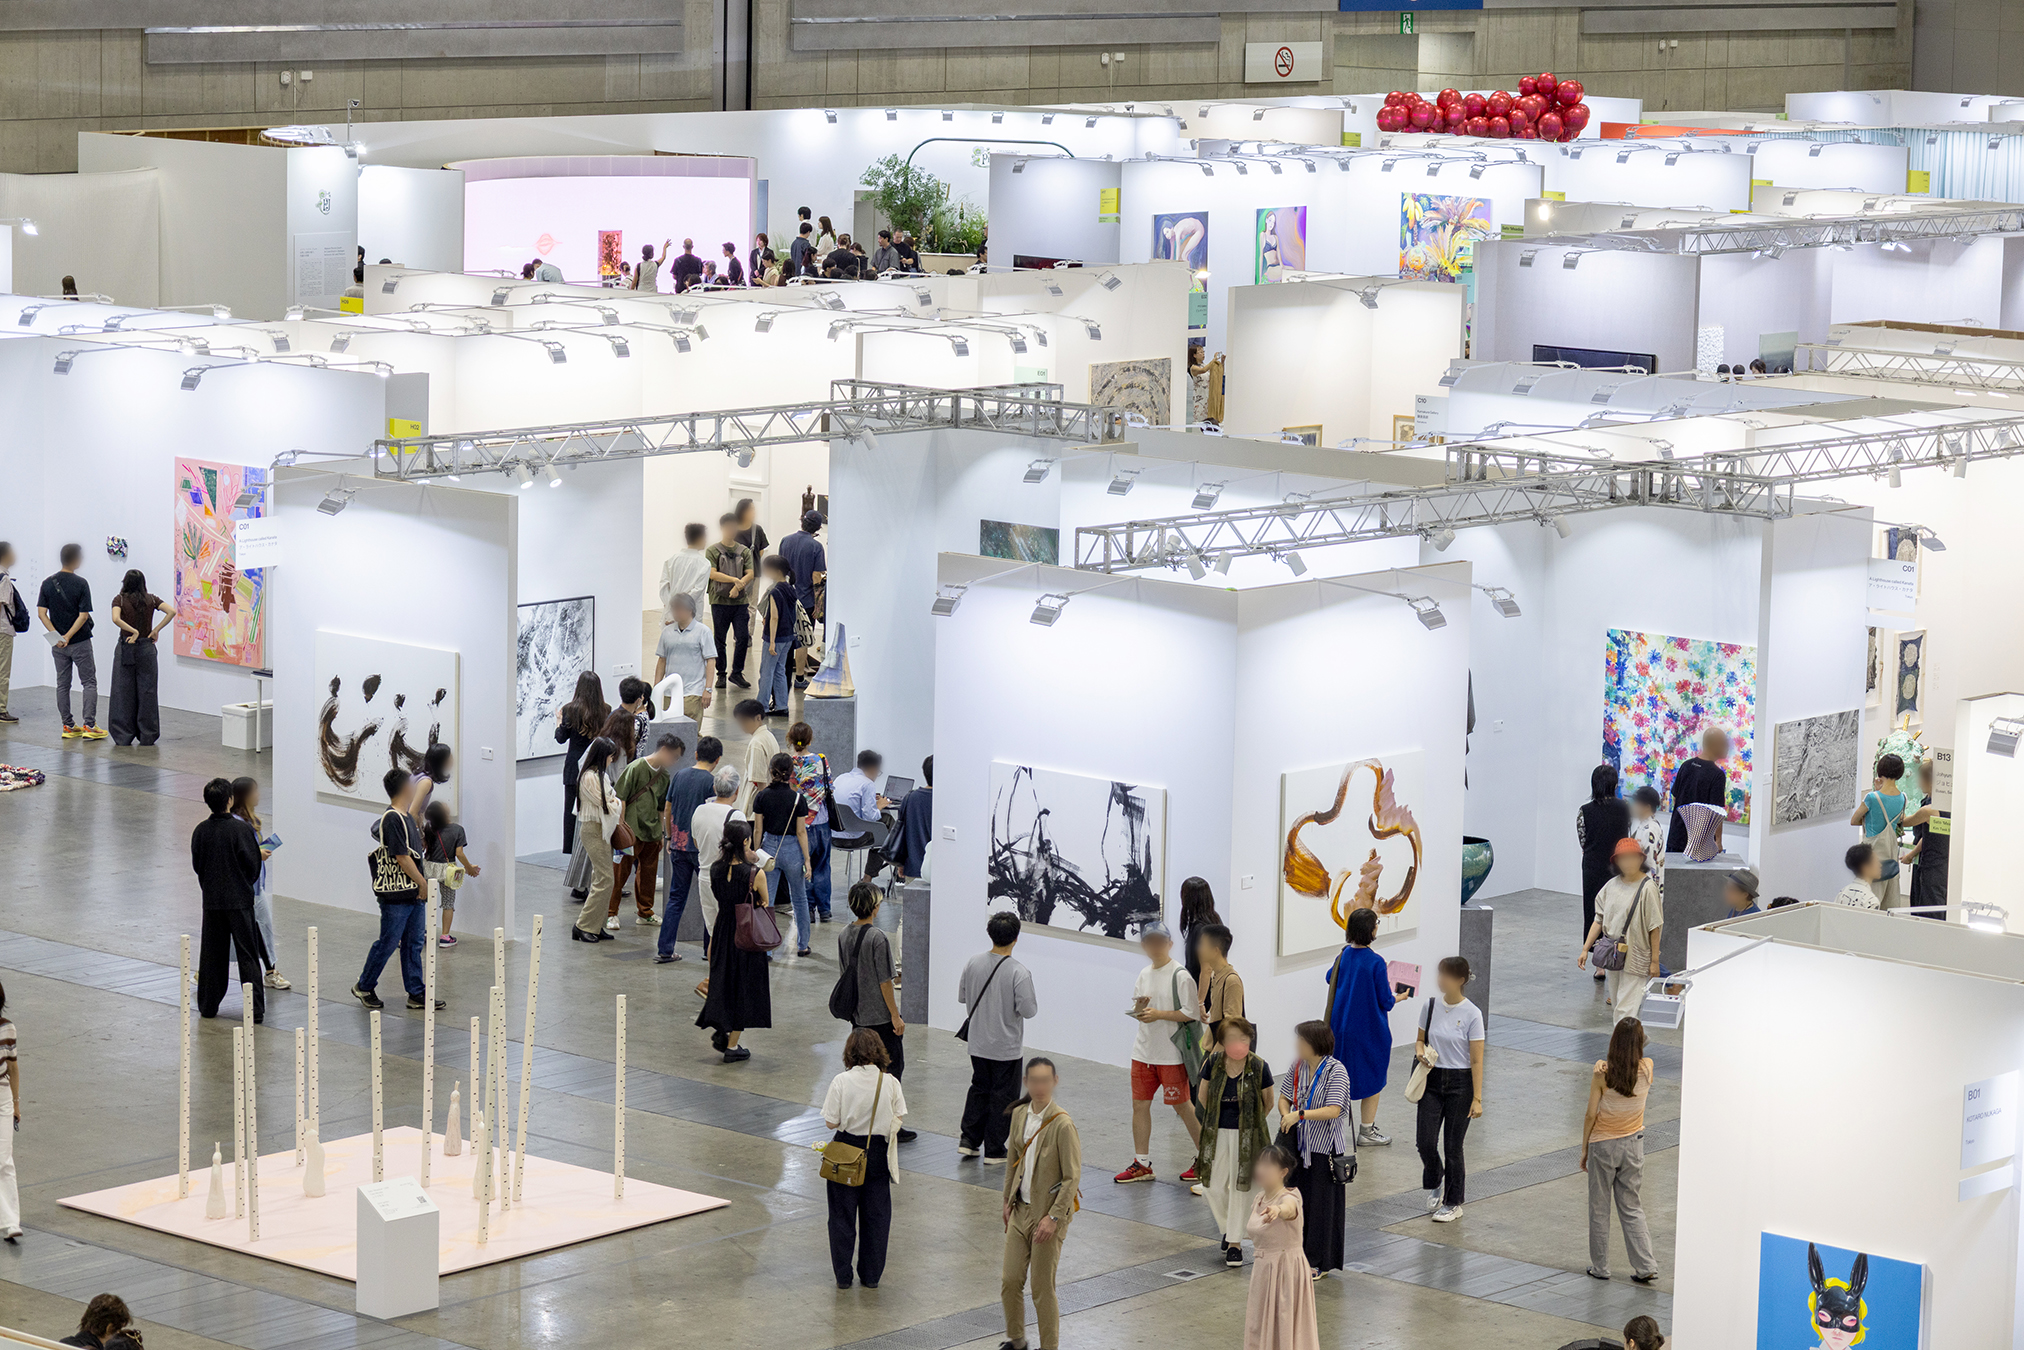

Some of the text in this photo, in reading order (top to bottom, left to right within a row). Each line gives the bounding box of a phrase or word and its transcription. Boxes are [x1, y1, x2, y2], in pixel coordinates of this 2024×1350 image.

[1937, 752, 1951, 761] B13
[1968, 1088, 1981, 1101] B01
[1966, 1107, 2002, 1122] KOTARO NUKAGA
